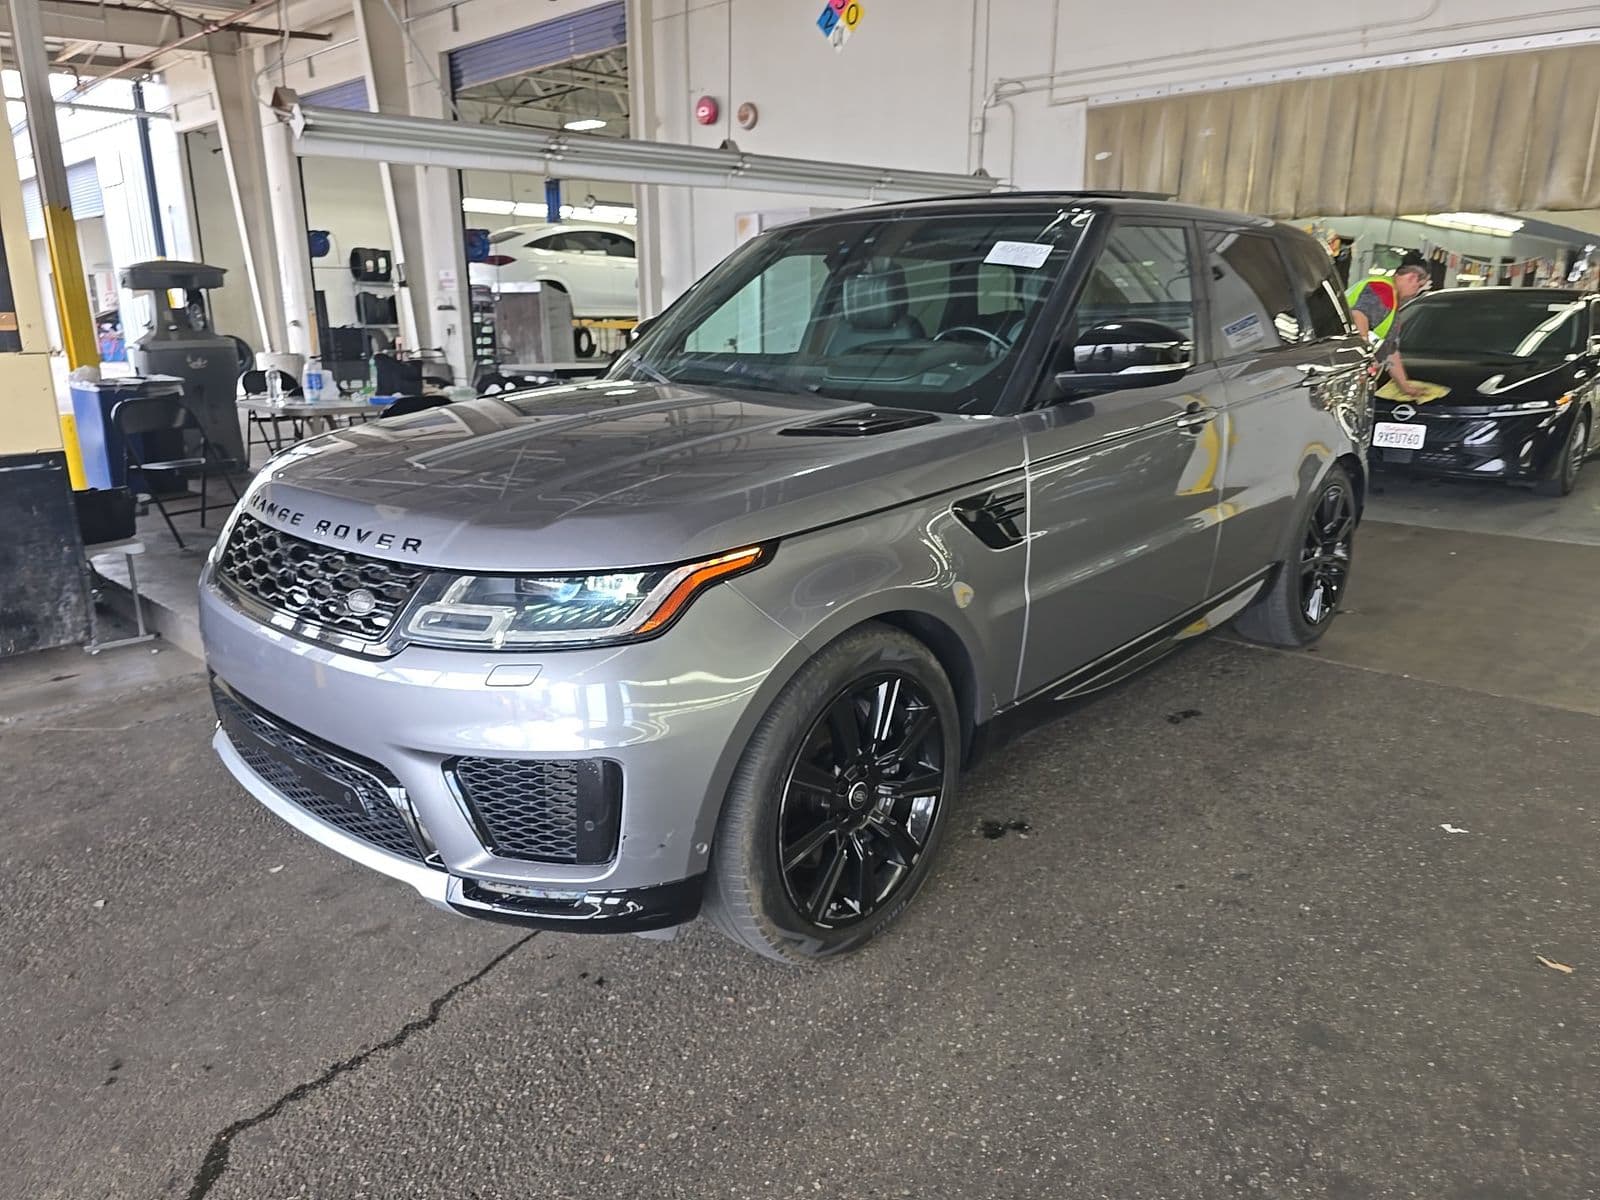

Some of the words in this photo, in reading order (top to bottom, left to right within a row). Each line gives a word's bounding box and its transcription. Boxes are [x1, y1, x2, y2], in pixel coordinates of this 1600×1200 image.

[822, 6, 834, 29] 2
[846, 3, 859, 26] 0
[313, 519, 422, 554] ROVER
